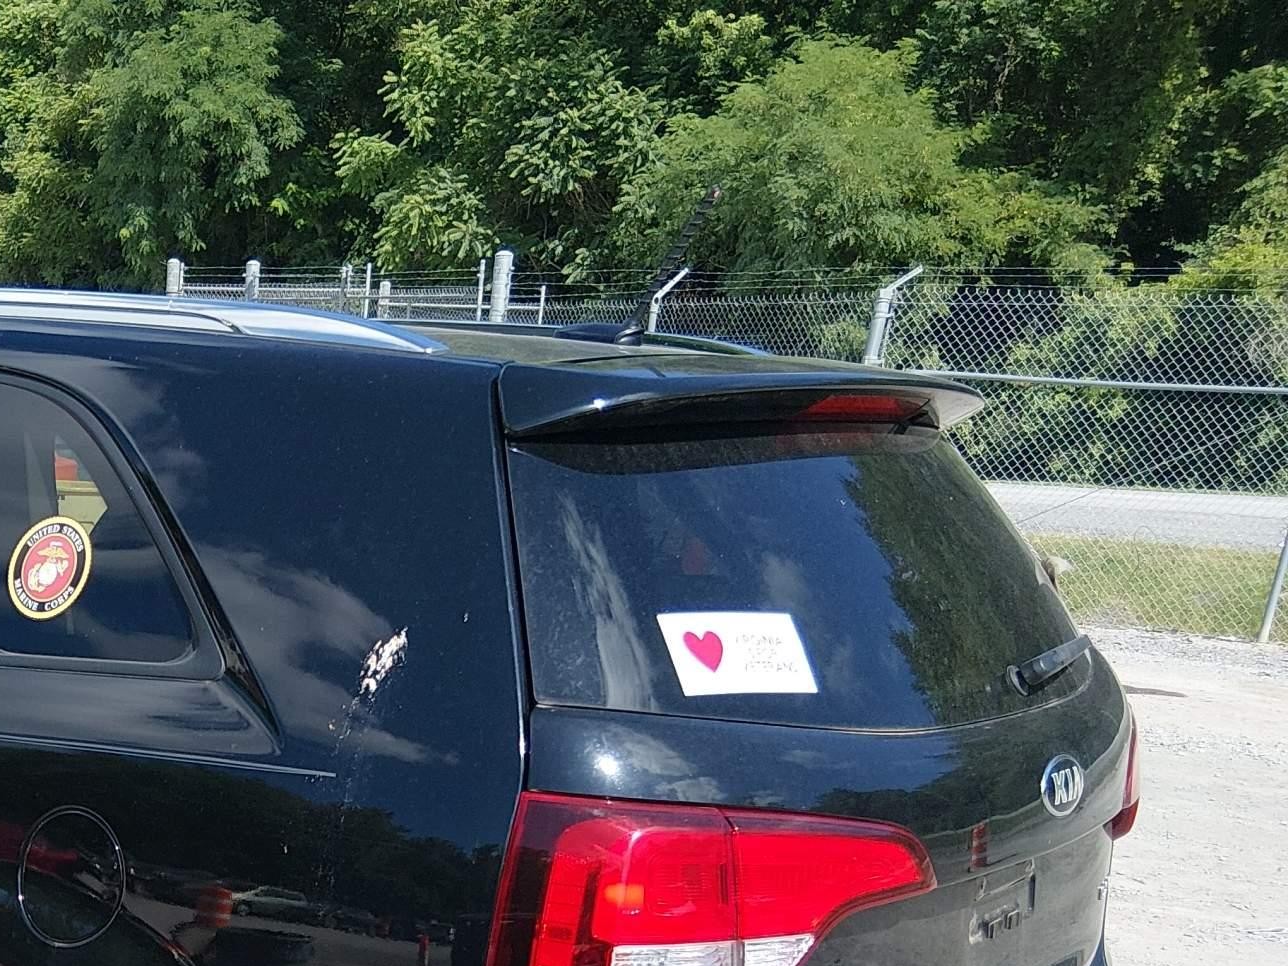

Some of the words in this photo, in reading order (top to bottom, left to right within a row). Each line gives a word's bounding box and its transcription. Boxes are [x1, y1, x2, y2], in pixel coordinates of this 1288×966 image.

[26, 524, 61, 548] UNITED
[61, 526, 84, 553] STATES
[14, 578, 39, 611] MARINE
[44, 585, 74, 611] CORPS
[1051, 765, 1082, 806] KIA
